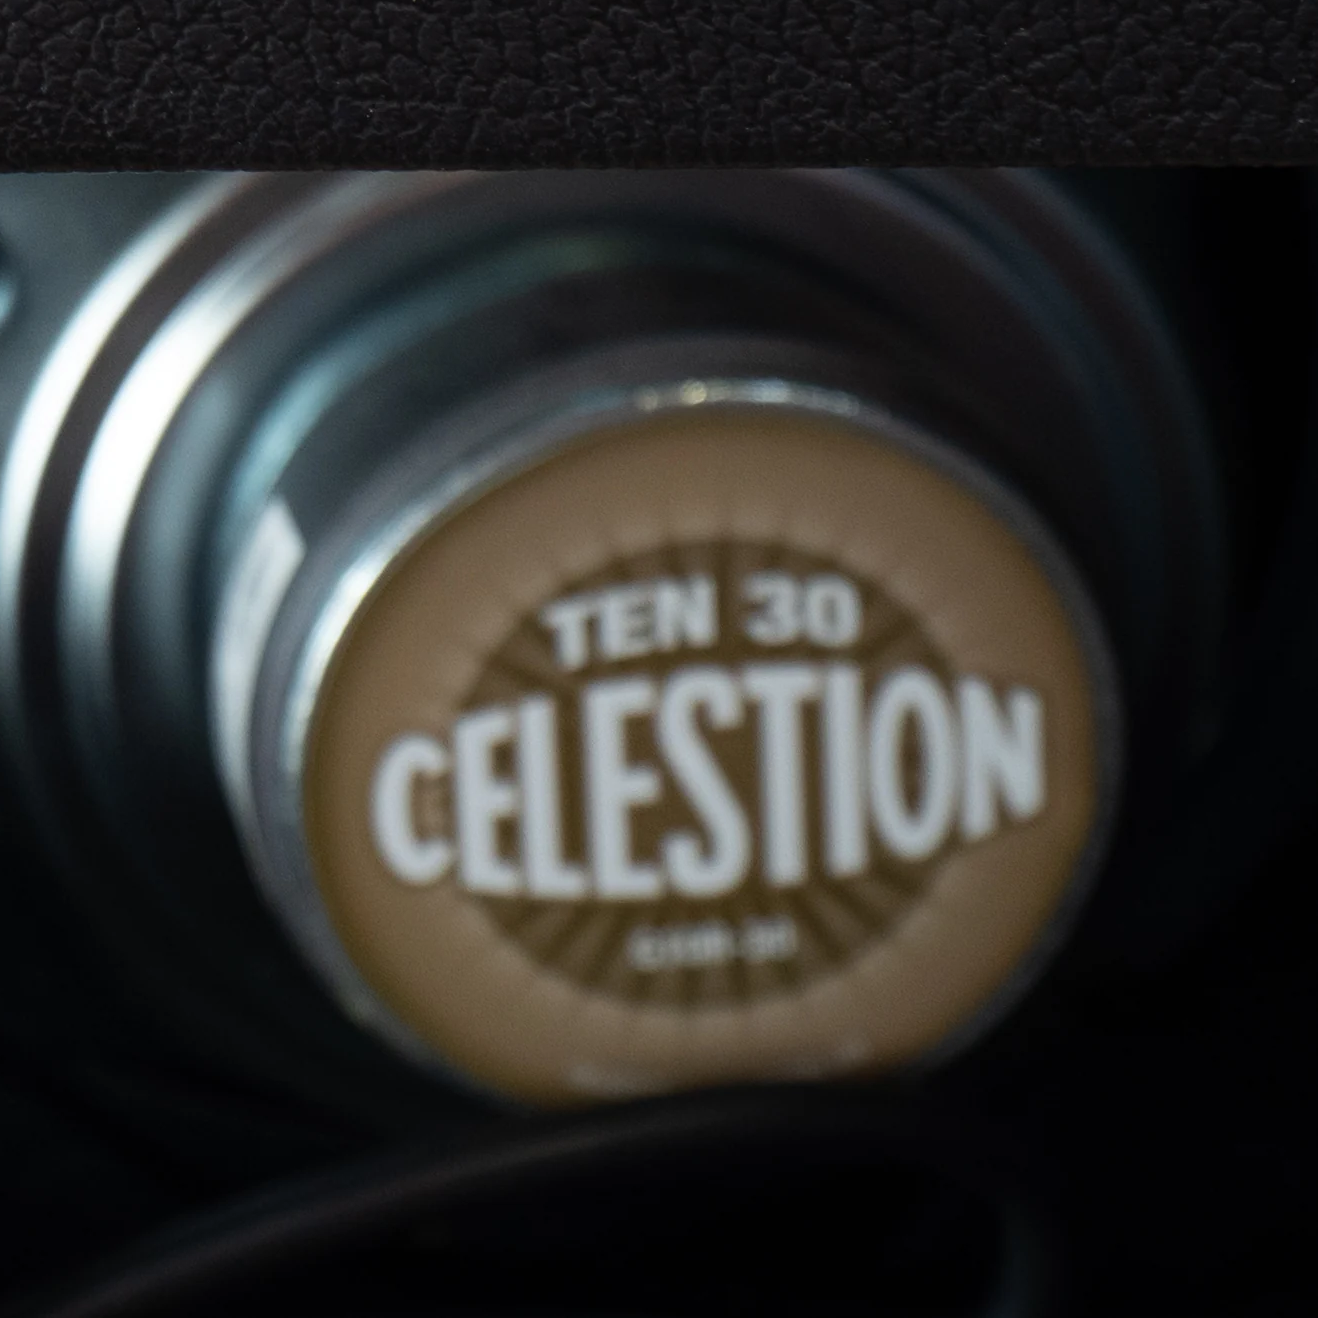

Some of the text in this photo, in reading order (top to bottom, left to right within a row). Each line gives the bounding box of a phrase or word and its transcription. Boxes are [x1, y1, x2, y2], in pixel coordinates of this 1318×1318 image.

[542, 573, 863, 672] TEN 30
[370, 662, 1046, 901] CELESTION
